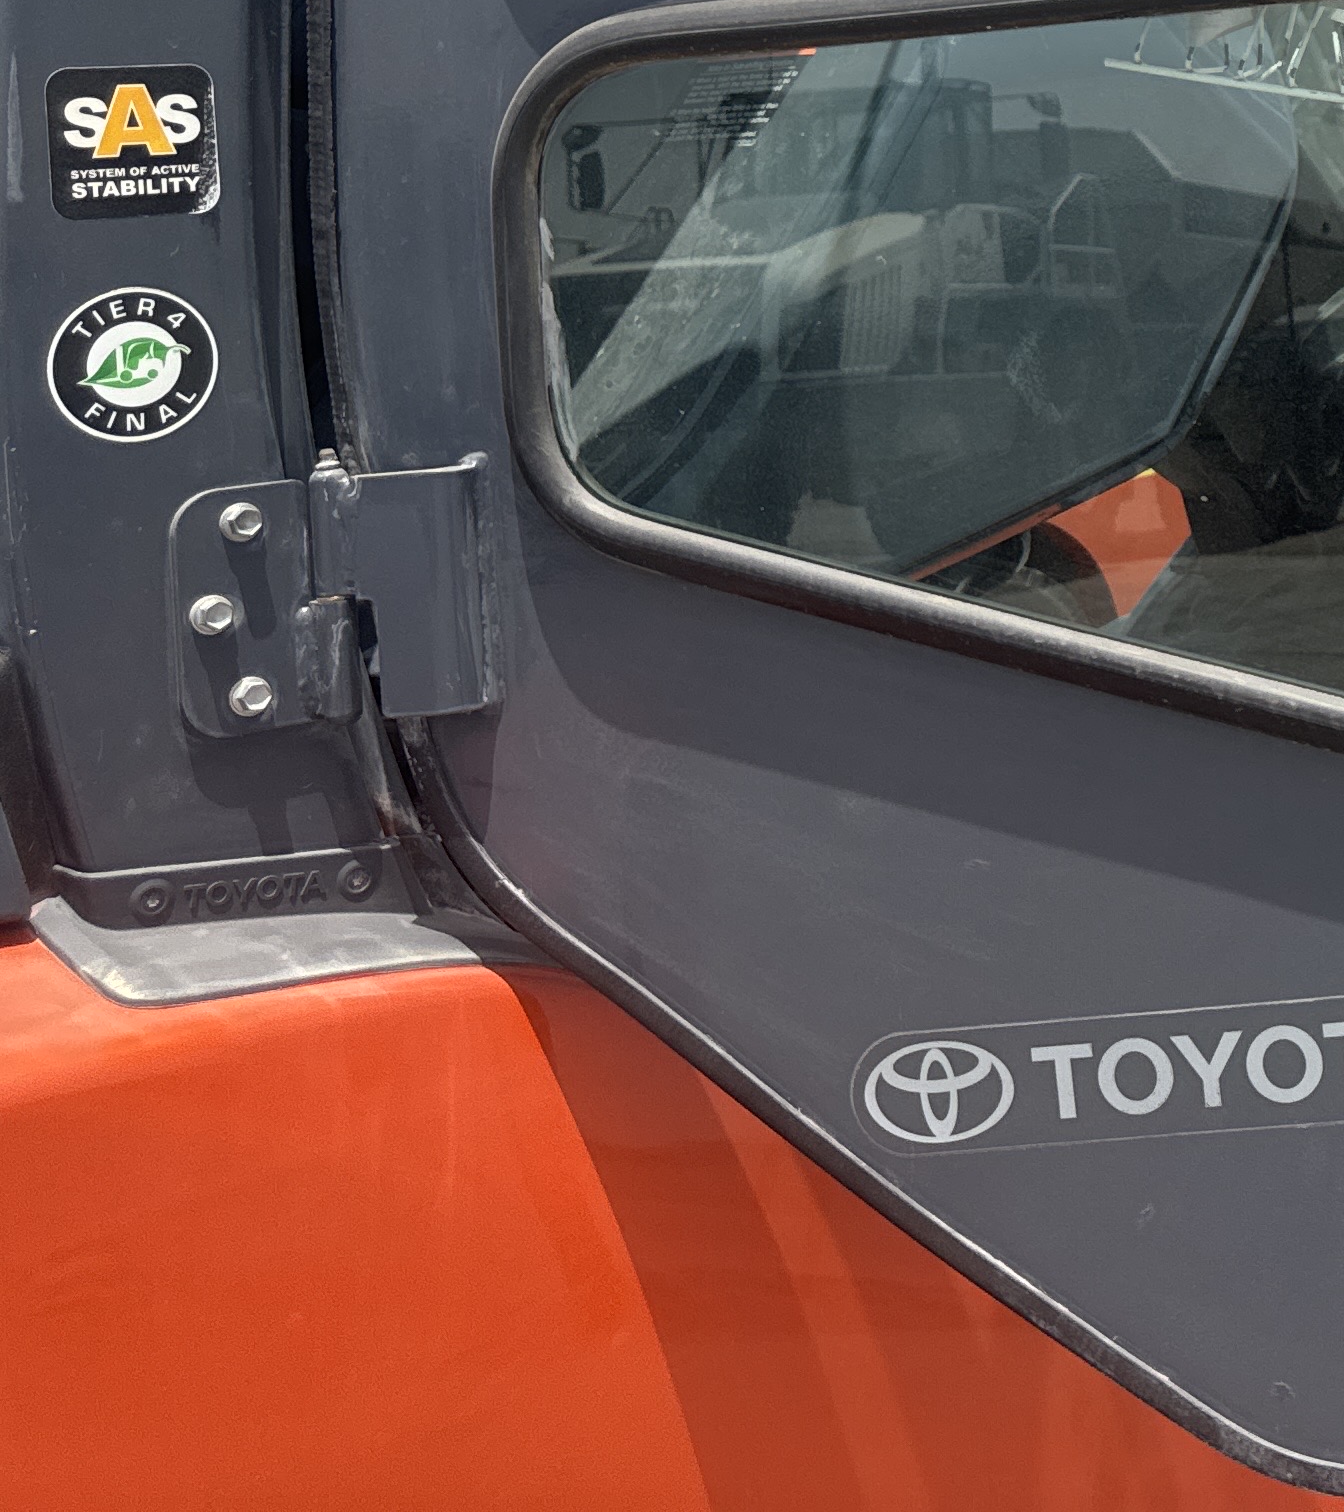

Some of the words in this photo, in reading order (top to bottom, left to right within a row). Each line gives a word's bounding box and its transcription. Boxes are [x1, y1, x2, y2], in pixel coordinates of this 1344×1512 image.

[63, 83, 201, 159] SAS
[70, 167, 125, 181] SYSTEM
[129, 165, 149, 178] OF
[151, 163, 201, 176] ACTIVE
[71, 175, 202, 200] STABILITY
[71, 297, 156, 341] TIER
[166, 311, 188, 330] 4
[84, 390, 198, 433] FINAL
[183, 869, 327, 911] TOYOTA
